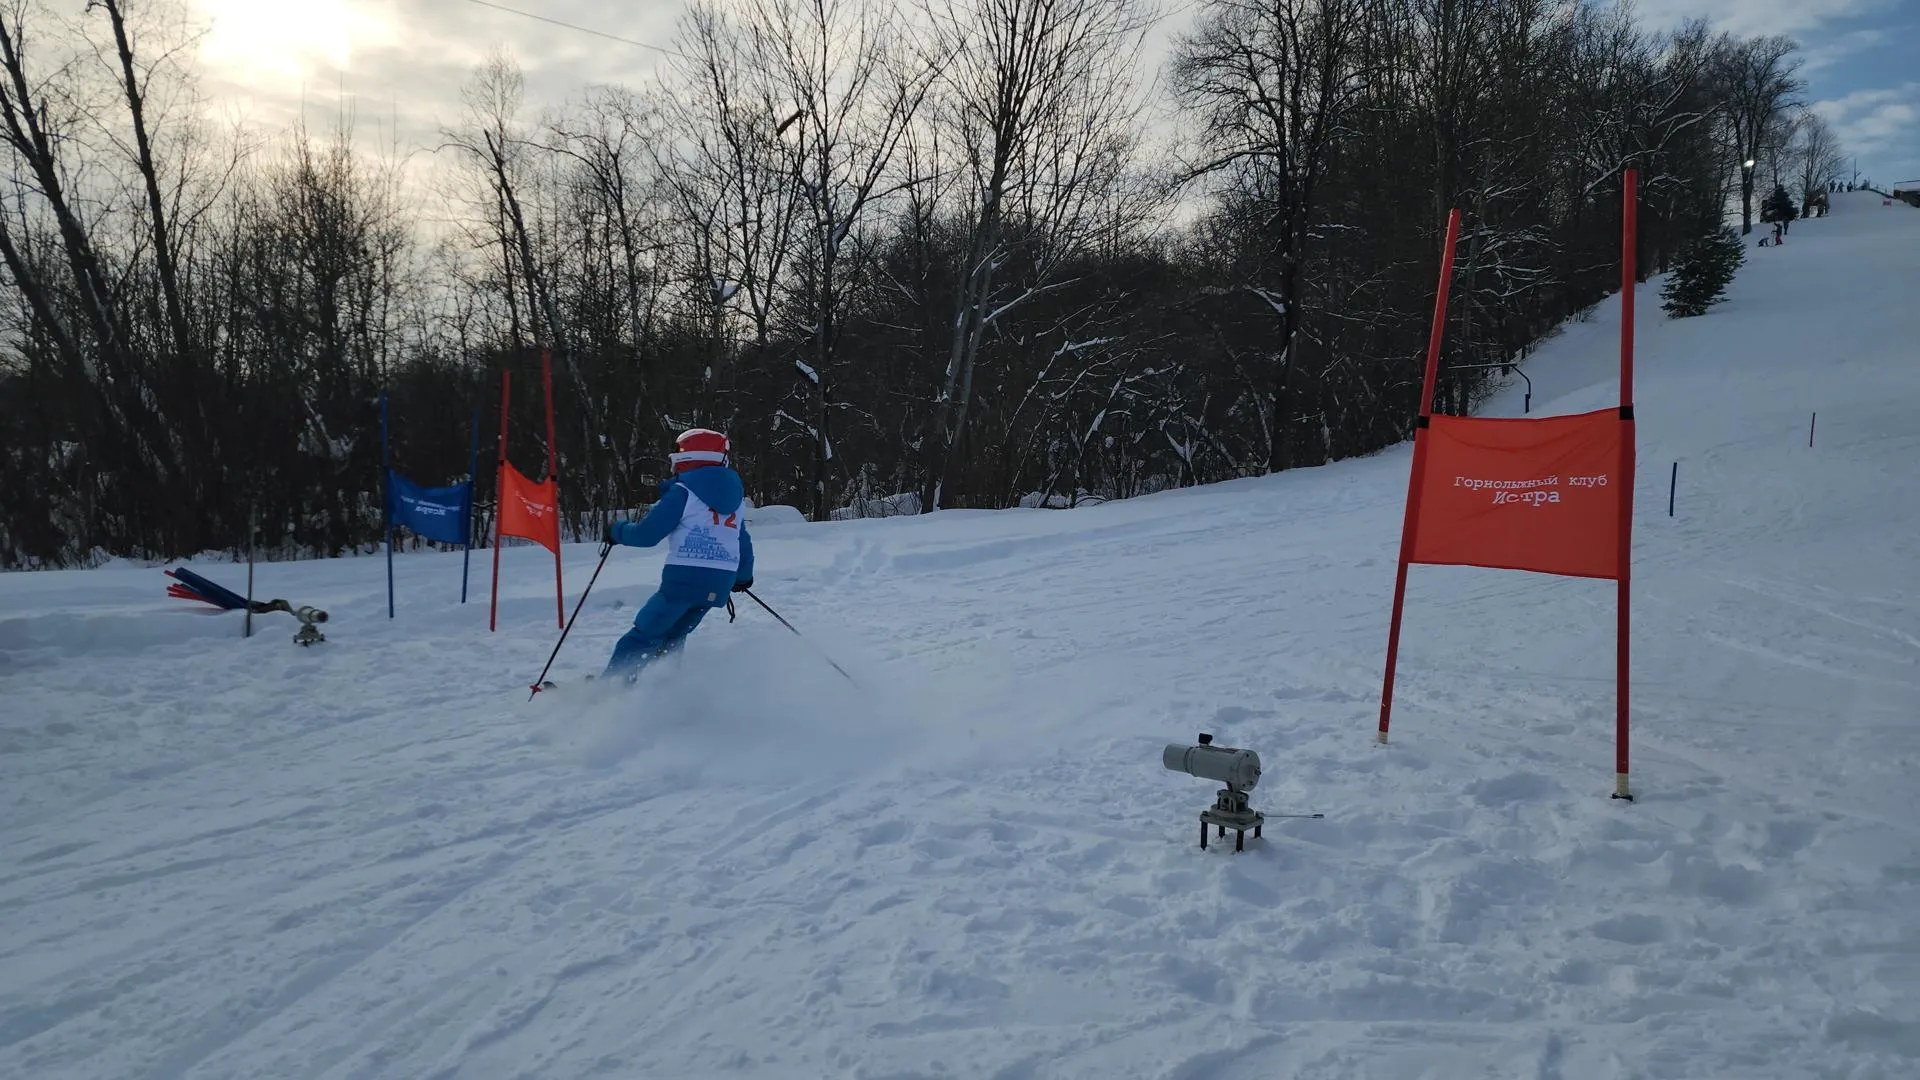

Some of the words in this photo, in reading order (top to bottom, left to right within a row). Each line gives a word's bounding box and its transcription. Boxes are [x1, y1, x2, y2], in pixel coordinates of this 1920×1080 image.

[1454, 475, 1558, 490] Горнолыжный
[1569, 474, 1608, 488] клуб
[1492, 490, 1560, 507] Истра
[708, 507, 738, 529] 12
